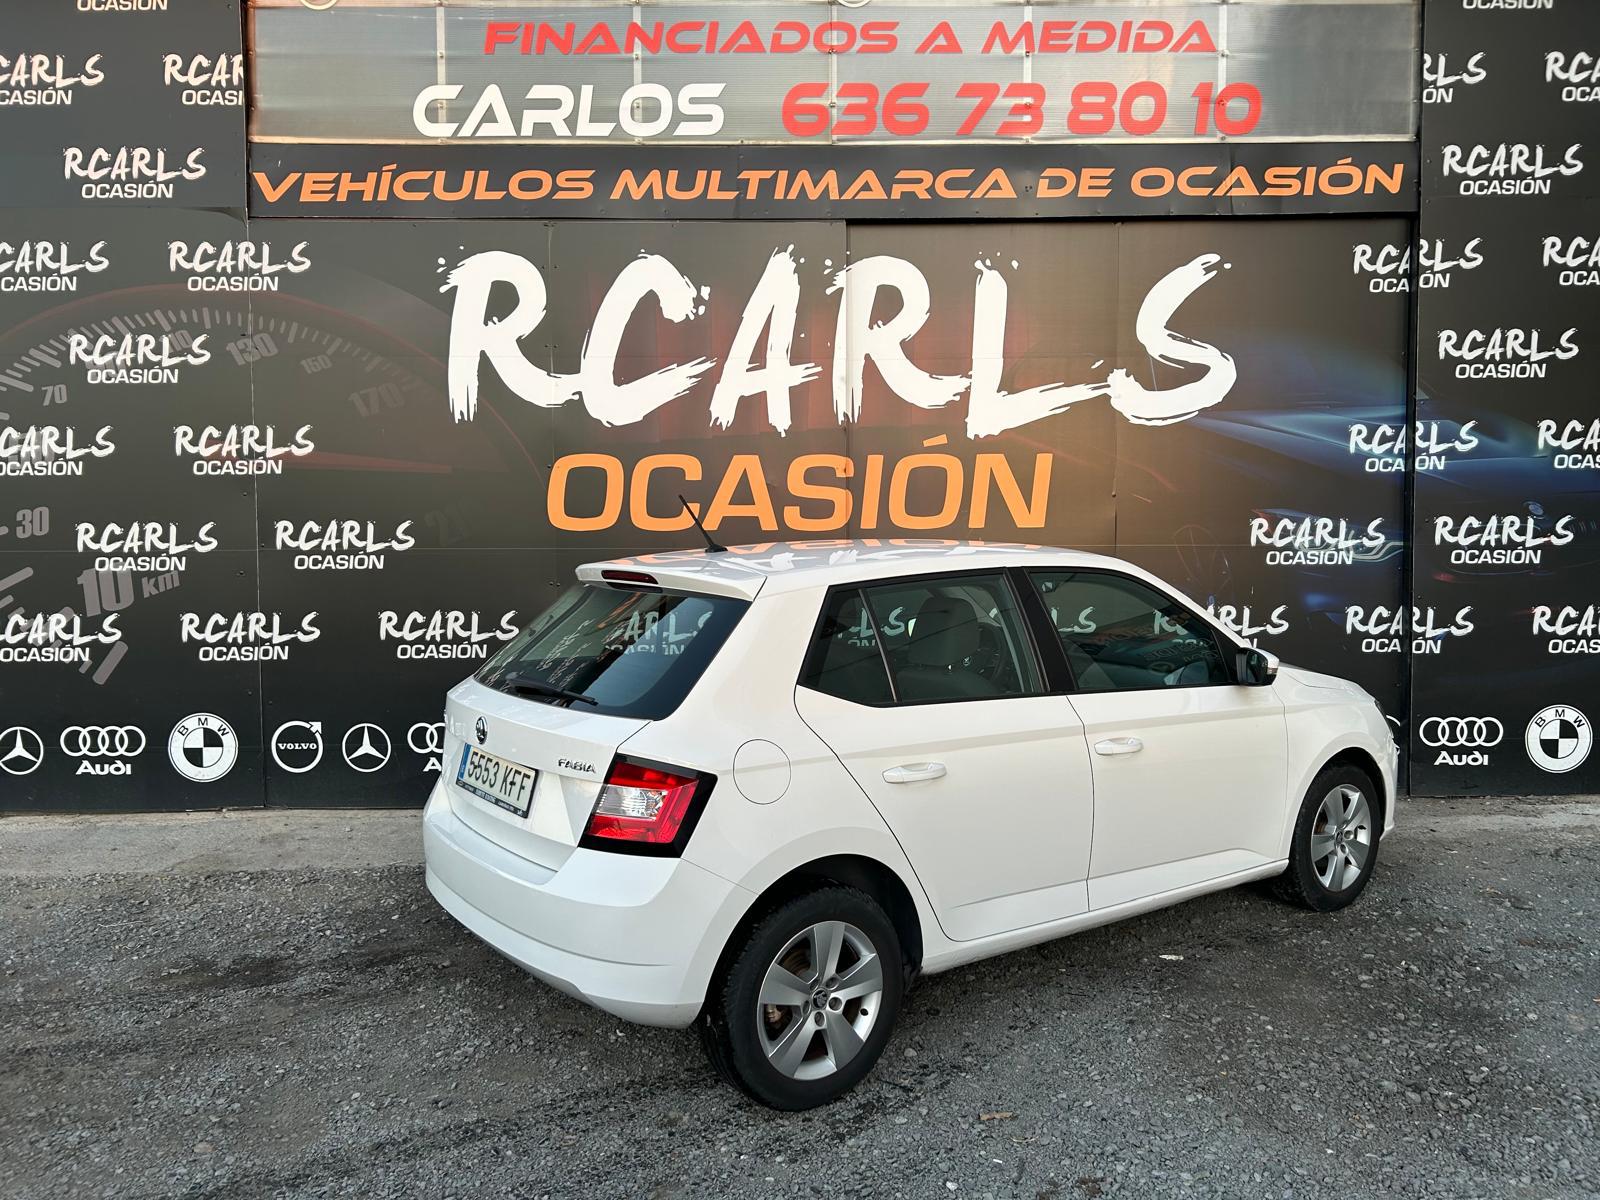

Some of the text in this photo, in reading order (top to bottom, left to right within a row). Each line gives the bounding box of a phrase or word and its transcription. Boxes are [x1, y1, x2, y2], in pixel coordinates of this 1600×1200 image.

[483, 20, 1217, 55] FINANCIADOS A MEDIDA
[412, 80, 1263, 137] CARLOS 636 73 80 10
[62, 145, 207, 183] RCARLS
[1441, 142, 1584, 179] RCARLS
[81, 179, 174, 199] OCASIÓN
[255, 159, 1404, 203] VEHÍCULOS MULTIMARCA DE OCASIÓN
[1459, 179, 1551, 196] OCASIÓN
[167, 239, 312, 275] RCARLS
[187, 272, 279, 292] OCASIÓN
[66, 331, 212, 368] RCARLS
[225, 332, 279, 366] 130
[436, 243, 1238, 441] RCARLS
[1437, 327, 1580, 363] RCARLS
[86, 365, 179, 384] OCASIÓN
[1455, 359, 1547, 379] OCASIÓN
[42, 384, 68, 406] 70
[173, 423, 315, 460] RCARLS
[192, 455, 283, 476] OCASIÓN
[547, 433, 1057, 532] OCASIÓN
[16, 507, 49, 539] 30
[75, 520, 219, 555] RCARLS
[274, 518, 416, 554] RCARLS
[1249, 516, 1386, 550] RCARLS
[1433, 514, 1574, 549] RCARLS
[94, 552, 186, 573] OCASIÓN
[294, 550, 385, 570] OCASIÓN
[1265, 546, 1354, 566] OCASIÓN
[1450, 545, 1542, 564] OCASIÓN
[141, 570, 181, 598] km
[0, 612, 122, 647] CARLS
[180, 611, 321, 646] RCARLS
[378, 609, 520, 644] RCARLS
[1532, 604, 1600, 638] RCA
[0, 643, 90, 664] OCASIÓN
[198, 642, 289, 662] OCASIÓN
[396, 640, 488, 659] OCASIÓN
[277, 741, 318, 751] VOLVO
[1433, 750, 1489, 766] Audi
[75, 759, 132, 776] Audi
[468, 751, 500, 788] 5553
[500, 765, 531, 801] KFF
[558, 758, 597, 774] FABIA
